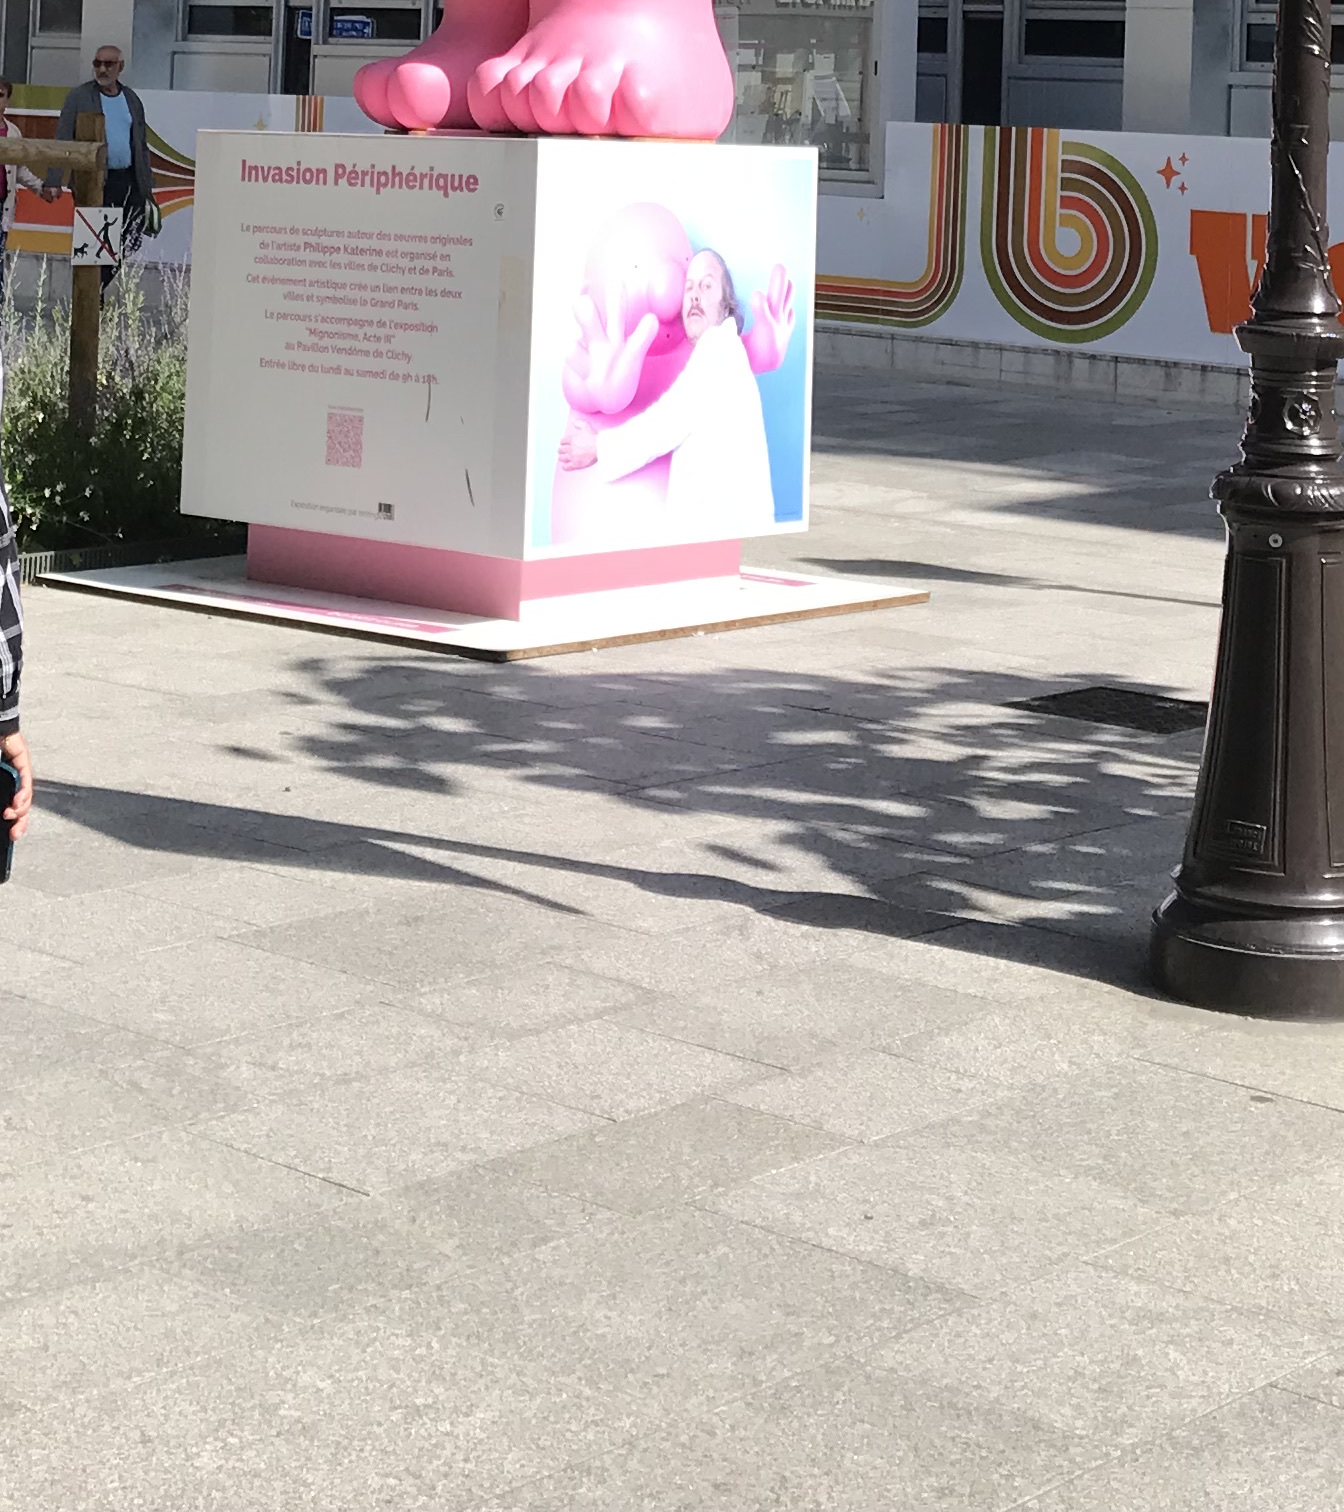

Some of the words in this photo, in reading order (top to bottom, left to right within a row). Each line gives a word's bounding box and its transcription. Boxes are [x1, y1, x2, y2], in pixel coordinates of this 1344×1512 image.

[240, 159, 328, 186] Invasion
[334, 162, 479, 198] Périphérique
[241, 223, 251, 233] Le
[252, 225, 288, 235] parcours
[289, 226, 301, 236] de
[302, 226, 345, 239] sculptures
[347, 230, 375, 240] autour
[376, 231, 392, 242] des
[430, 234, 473, 247] originales
[259, 240, 270, 250] de
[303, 242, 341, 256] Philippe
[343, 244, 384, 258] Katerine
[385, 249, 398, 259] est
[400, 251, 438, 262] organisé
[439, 253, 451, 262] en
[254, 255, 307, 267] collaboration
[308, 259, 328, 268] avec
[329, 259, 342, 270] les
[344, 260, 366, 271] villes
[367, 262, 378, 272] de
[380, 262, 406, 276] Clichy
[408, 266, 416, 275] et
[419, 266, 430, 276] de
[432, 266, 455, 278] Paris.
[246, 273, 259, 284] Cet
[308, 278, 350, 292] artistique
[370, 284, 381, 293] un
[382, 283, 398, 294] lien
[400, 285, 423, 296] entre
[425, 286, 438, 298] les
[440, 288, 462, 299] deux
[283, 291, 305, 302] villes
[306, 293, 314, 302] et
[316, 294, 358, 306] symbolise
[359, 296, 368, 307] le
[370, 298, 395, 309] Grand
[397, 299, 419, 311] Paris.
[264, 309, 274, 320] Le
[276, 312, 313, 323] parcours
[314, 314, 374, 329] s'accompagne
[376, 318, 387, 329] de
[389, 319, 438, 333] l'exposition
[362, 332, 382, 343] Acte
[284, 342, 295, 351] au
[297, 341, 329, 354] Pavillon
[330, 344, 371, 357] Vendôme
[372, 349, 383, 359] de
[386, 349, 412, 364] Clichy
[259, 357, 287, 369] Entrée
[287, 360, 306, 372] libre
[308, 363, 319, 373] du
[320, 364, 342, 375] lundi
[344, 367, 354, 376] au
[356, 369, 387, 380] samedi
[389, 371, 400, 381] de
